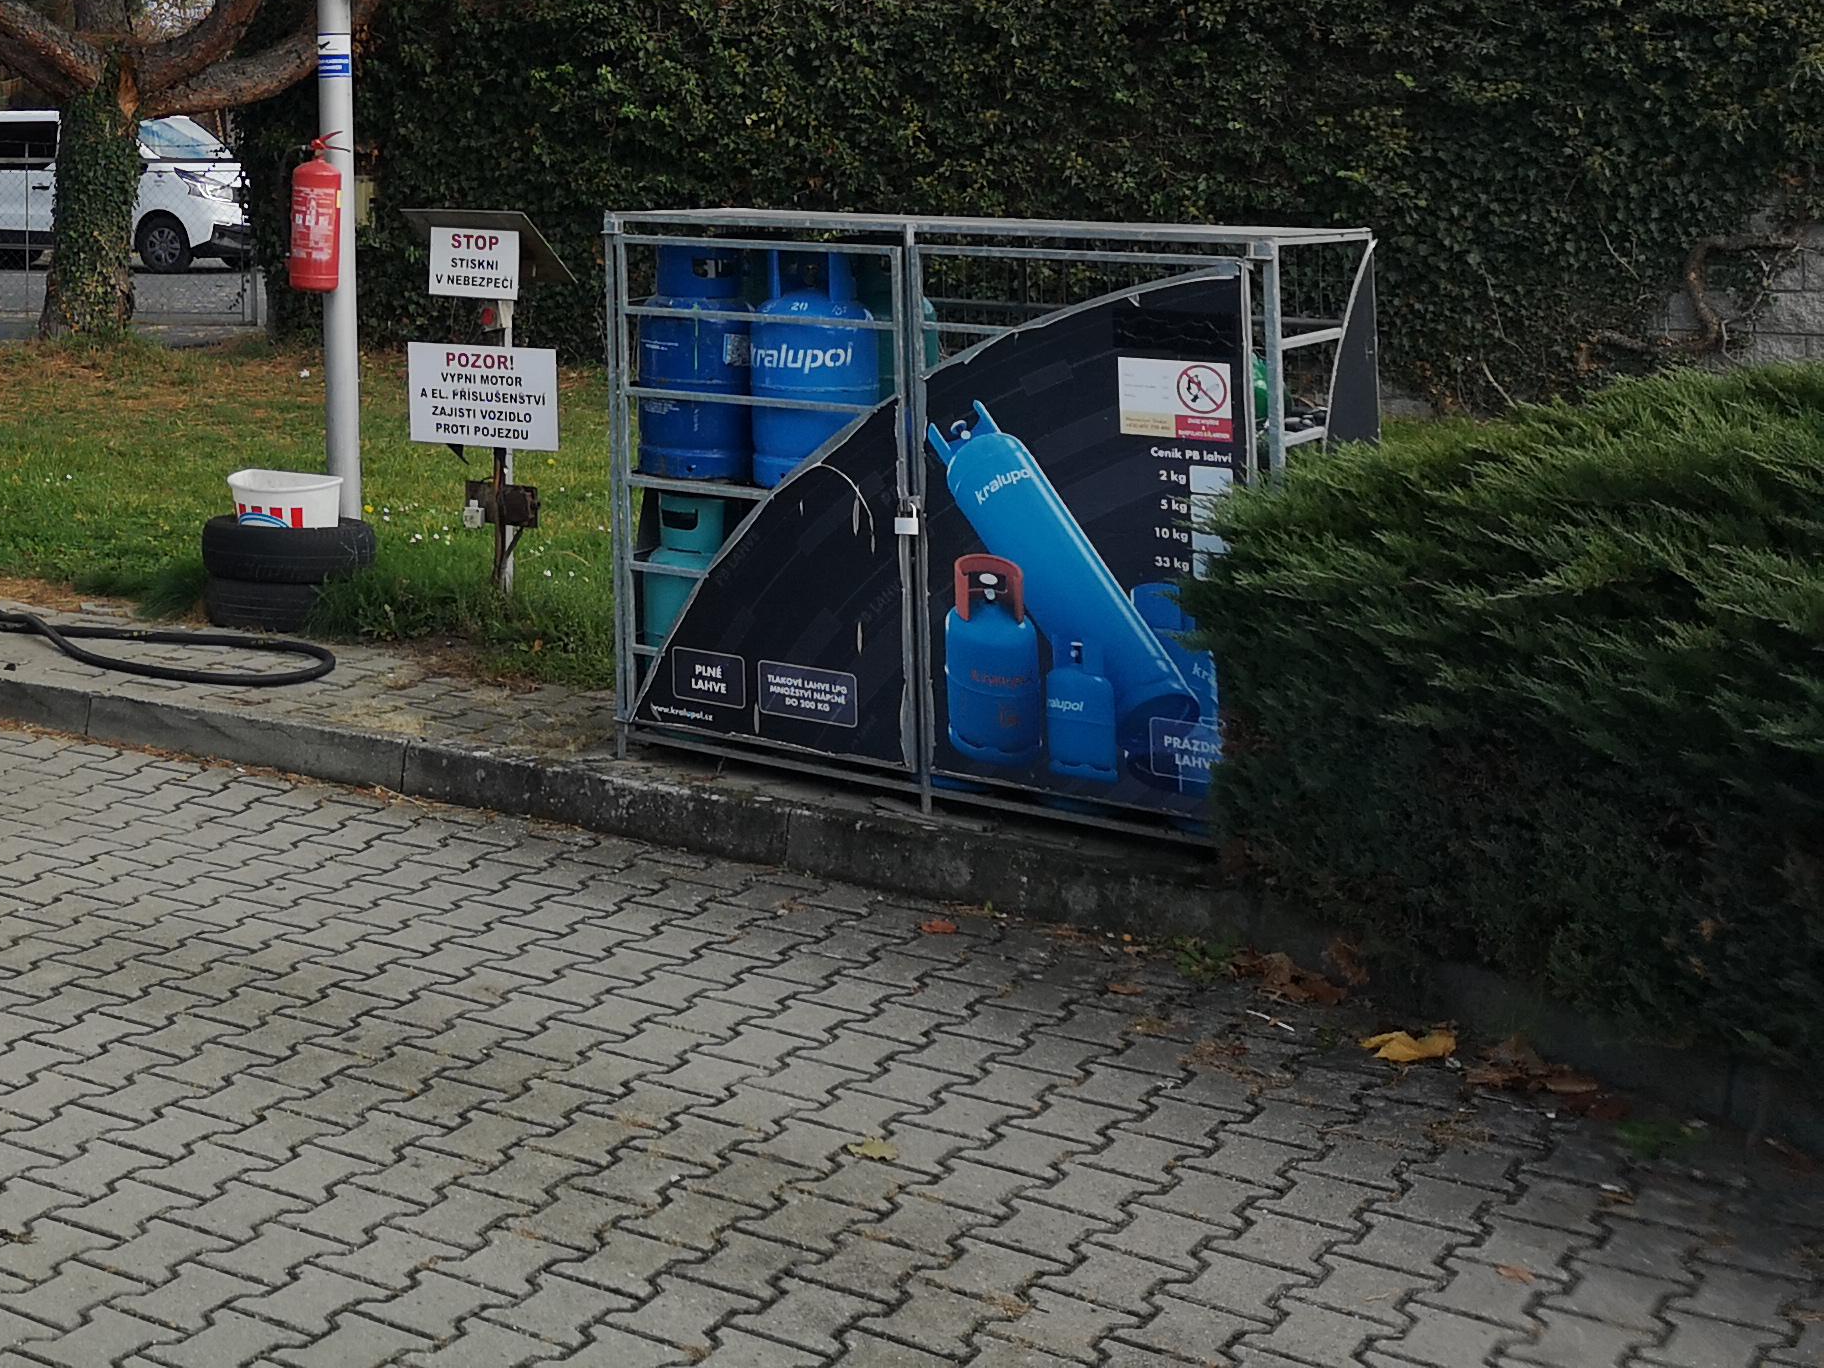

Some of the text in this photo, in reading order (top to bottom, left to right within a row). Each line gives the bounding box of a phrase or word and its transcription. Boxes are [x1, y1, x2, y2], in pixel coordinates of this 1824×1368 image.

[451, 233, 499, 251] STOP
[451, 257, 498, 271] STISKNI
[435, 273, 513, 289] V NEBEZPEČÍ
[446, 352, 514, 371] POZOR!
[441, 372, 523, 387] VYPNI MOTOR
[420, 387, 428, 398] A
[431, 388, 449, 400] EL.
[432, 406, 532, 423] ZAJISTI VOZIDLO
[435, 422, 529, 440] PROTI POJEZDU
[1185, 449, 1200, 461] PB
[1159, 470, 1187, 485] 2 kg
[975, 468, 1033, 505] kralupo
[1160, 499, 1188, 514] 5 kg
[1154, 527, 1189, 543] 10 kg
[1154, 556, 1190, 572] 33 kg
[695, 664, 722, 679] PLNÉ
[691, 678, 727, 694] LAHVE
[804, 679, 830, 691] LAHVE
[831, 684, 848, 694] LPG
[785, 697, 798, 706] DO
[817, 702, 830, 712] KG
[1164, 734, 1223, 755] PRÁZDN
[1175, 753, 1213, 770] LAHV
